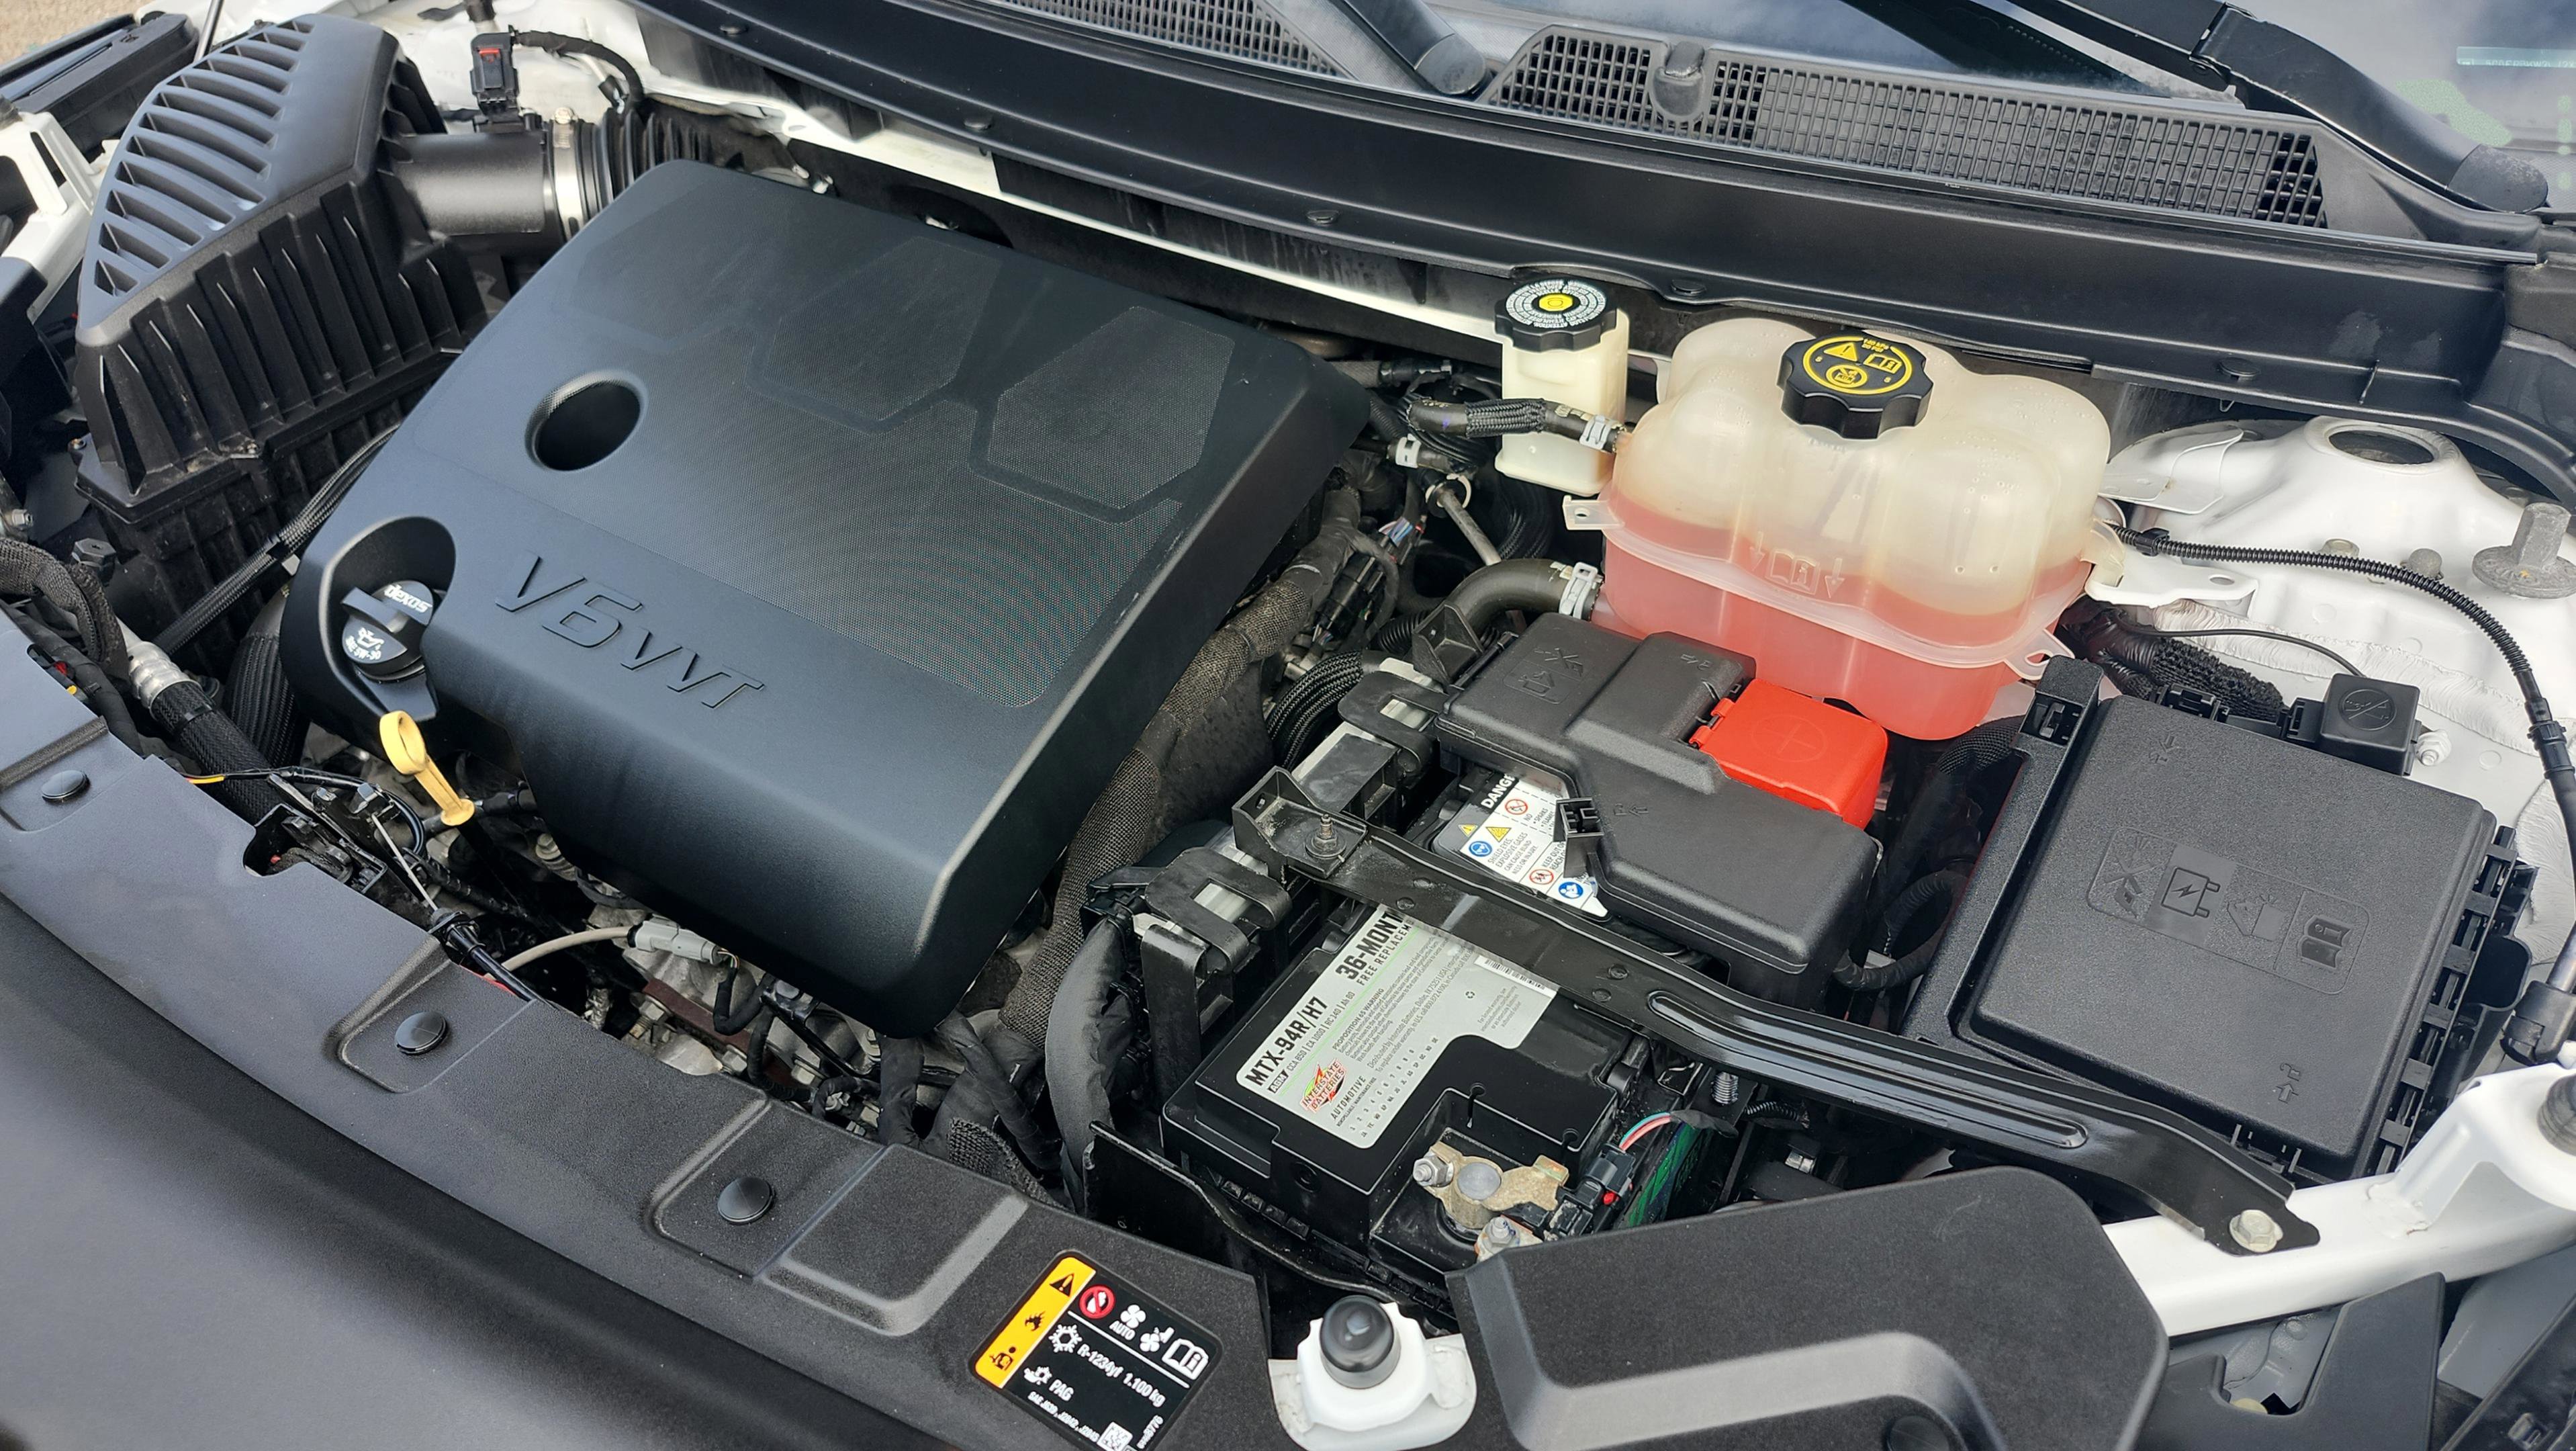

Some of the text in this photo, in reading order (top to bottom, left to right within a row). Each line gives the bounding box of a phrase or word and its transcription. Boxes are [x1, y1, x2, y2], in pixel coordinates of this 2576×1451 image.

[383, 583, 433, 613] dexos
[1523, 814, 1532, 822] NO
[1487, 848, 1504, 864] SHIELD
[1496, 832, 1528, 867] EXPLOSIVE GASES
[1542, 856, 1553, 867] KEEP
[1550, 847, 1561, 857] OUT
[1549, 856, 1564, 871] REACH
[1334, 910, 1404, 980] 36-MONT
[1355, 965, 1379, 985] FREE
[1332, 1017, 1361, 1049] PROPOSITION
[1363, 988, 1384, 1010] WARNING
[1244, 996, 1328, 1086] MTX-94R/H7
[1268, 1072, 1289, 1092] AGM
[1285, 1059, 1299, 1071] CCA
[1293, 1049, 1307, 1061] 850
[1305, 1039, 1317, 1048] CA
[1300, 1061, 1340, 1107] INTERSTATE
[1309, 1068, 1346, 1109] BATTERIES
[1328, 1075, 1367, 1120] AUTOMOTIVE
[1109, 1319, 1136, 1341] AUTO
[1048, 1378, 1074, 1402] PAG
[1076, 1344, 1166, 1409] R-1234yf 1.100 kg
[1027, 1391, 1044, 1405] SAE
